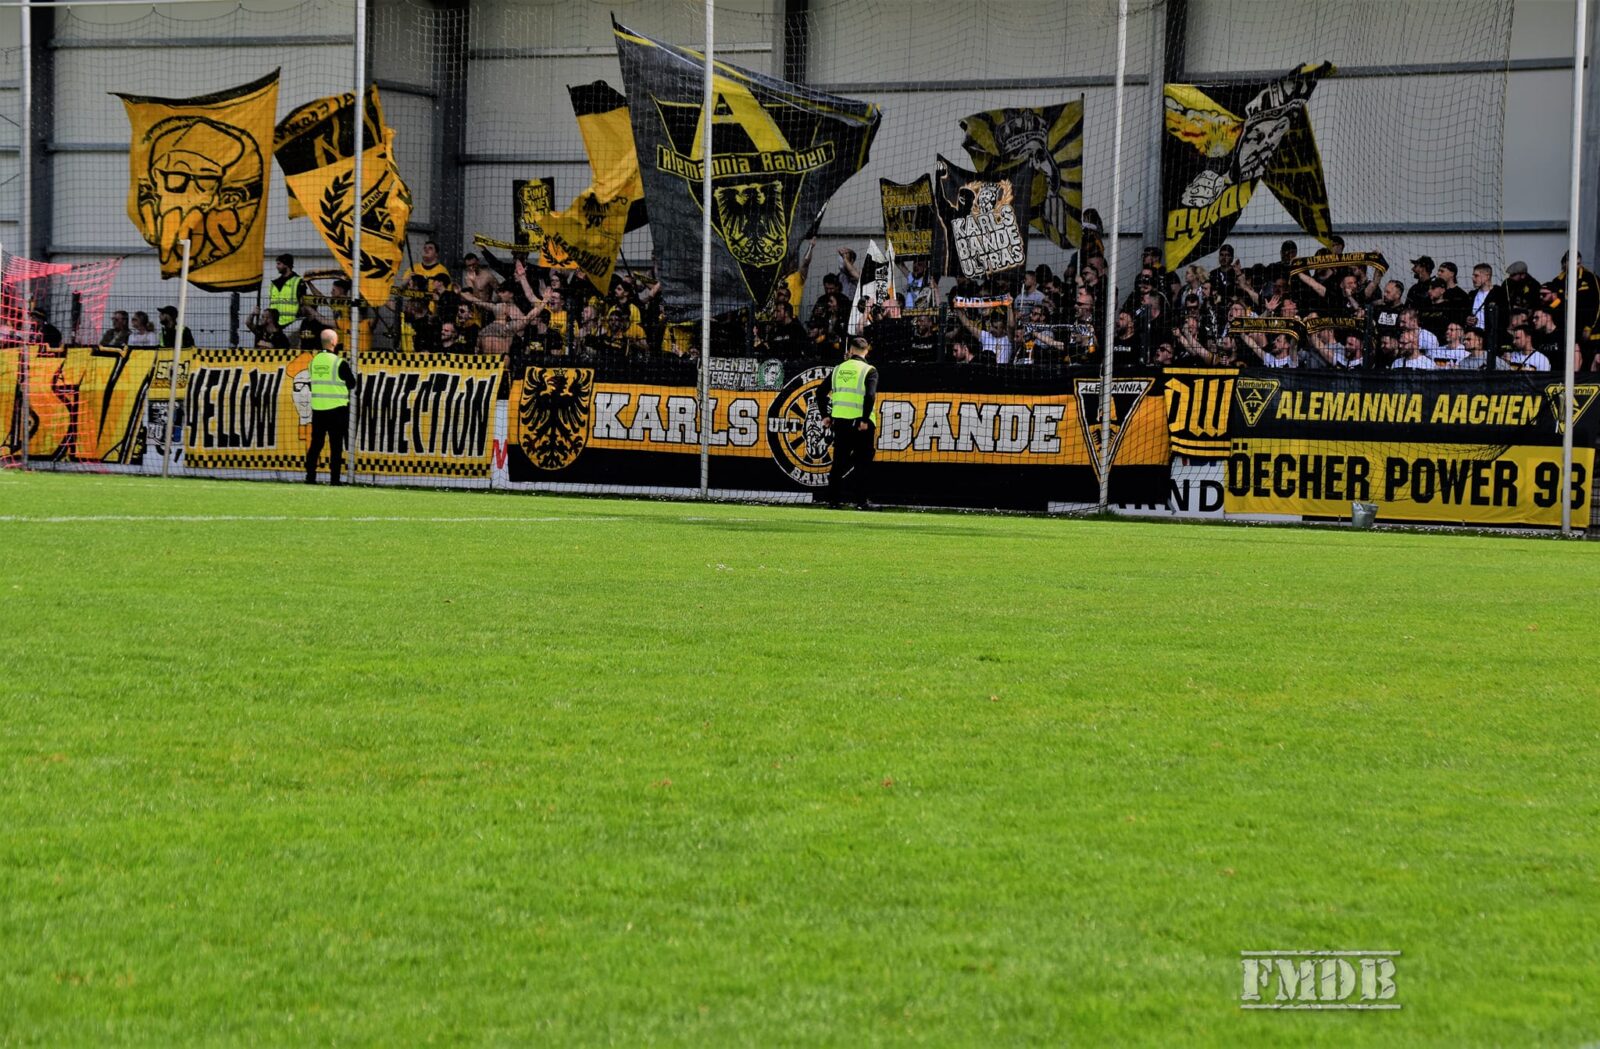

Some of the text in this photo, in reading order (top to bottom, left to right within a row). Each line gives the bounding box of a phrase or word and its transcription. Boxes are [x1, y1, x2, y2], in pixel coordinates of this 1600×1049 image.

[761, 147, 827, 172] Aachen
[951, 204, 1015, 240] KARLS
[956, 226, 1021, 260] BANDE
[961, 246, 1025, 278] ULTRAS
[1080, 382, 1143, 394] ALEANNIA
[186, 367, 497, 457] YELLOW NNECTION
[593, 392, 1066, 453] KARLS BANDE
[1276, 391, 1542, 425] ALEMANNIA AACHEN
[1228, 442, 1370, 501] ÖECHER
[1384, 457, 1518, 507] POWER
